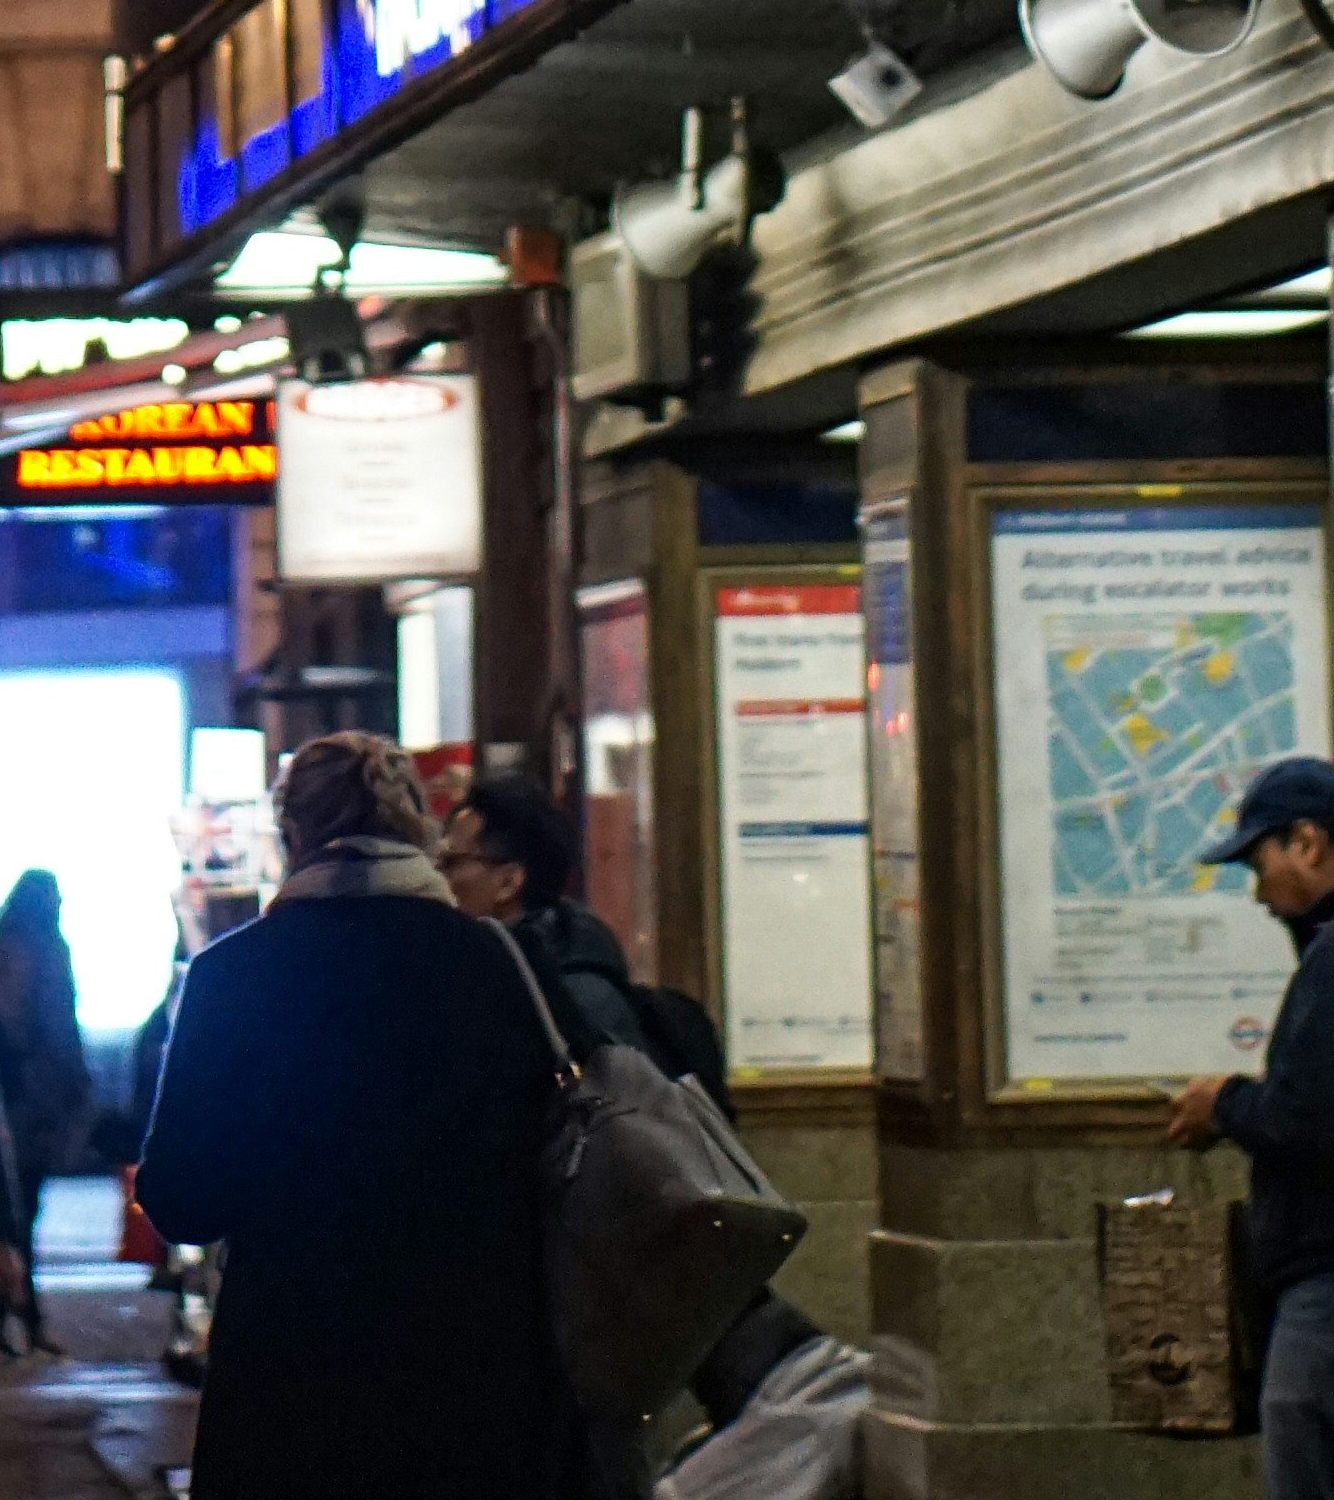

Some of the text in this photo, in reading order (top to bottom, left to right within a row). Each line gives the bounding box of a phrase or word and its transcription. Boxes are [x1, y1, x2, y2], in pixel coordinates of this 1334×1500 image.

[1022, 546, 1310, 569] Alternative travel advice
[1021, 583, 1097, 604] during
[1221, 579, 1291, 597] works
